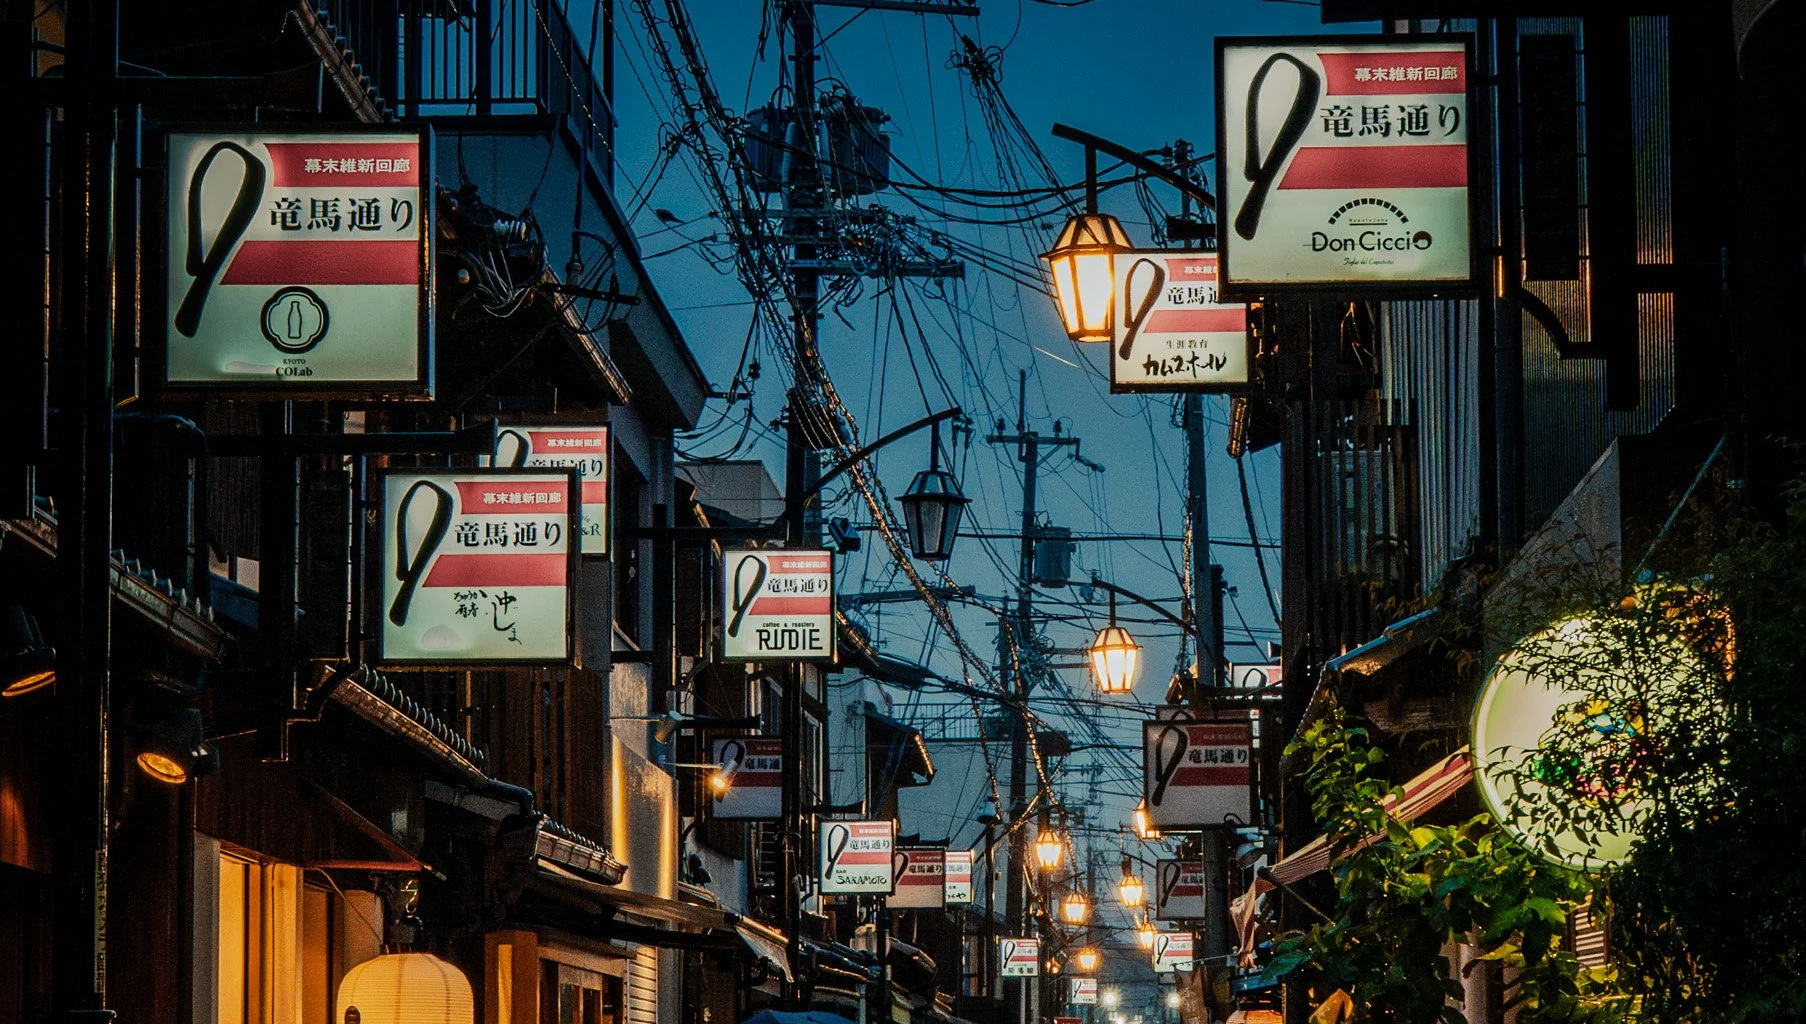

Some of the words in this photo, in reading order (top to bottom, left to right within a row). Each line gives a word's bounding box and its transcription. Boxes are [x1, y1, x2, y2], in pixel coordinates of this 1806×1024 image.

[1355, 67, 1457, 81] 幕末維新回廊
[1320, 104, 1460, 138] 竜馬通り
[305, 158, 410, 173] 幕末維新回廊
[269, 197, 413, 232] 竜馬通り
[1312, 231, 1355, 252] Don
[1359, 230, 1432, 251] Ciccio
[276, 366, 313, 377] COLab
[483, 492, 561, 504] 幕末維新回廊
[454, 521, 561, 547] 竜馬通り
[768, 578, 828, 593] 竜馬通り
[756, 629, 823, 650] RUDIE
[835, 875, 887, 885] SAKAMOTO
